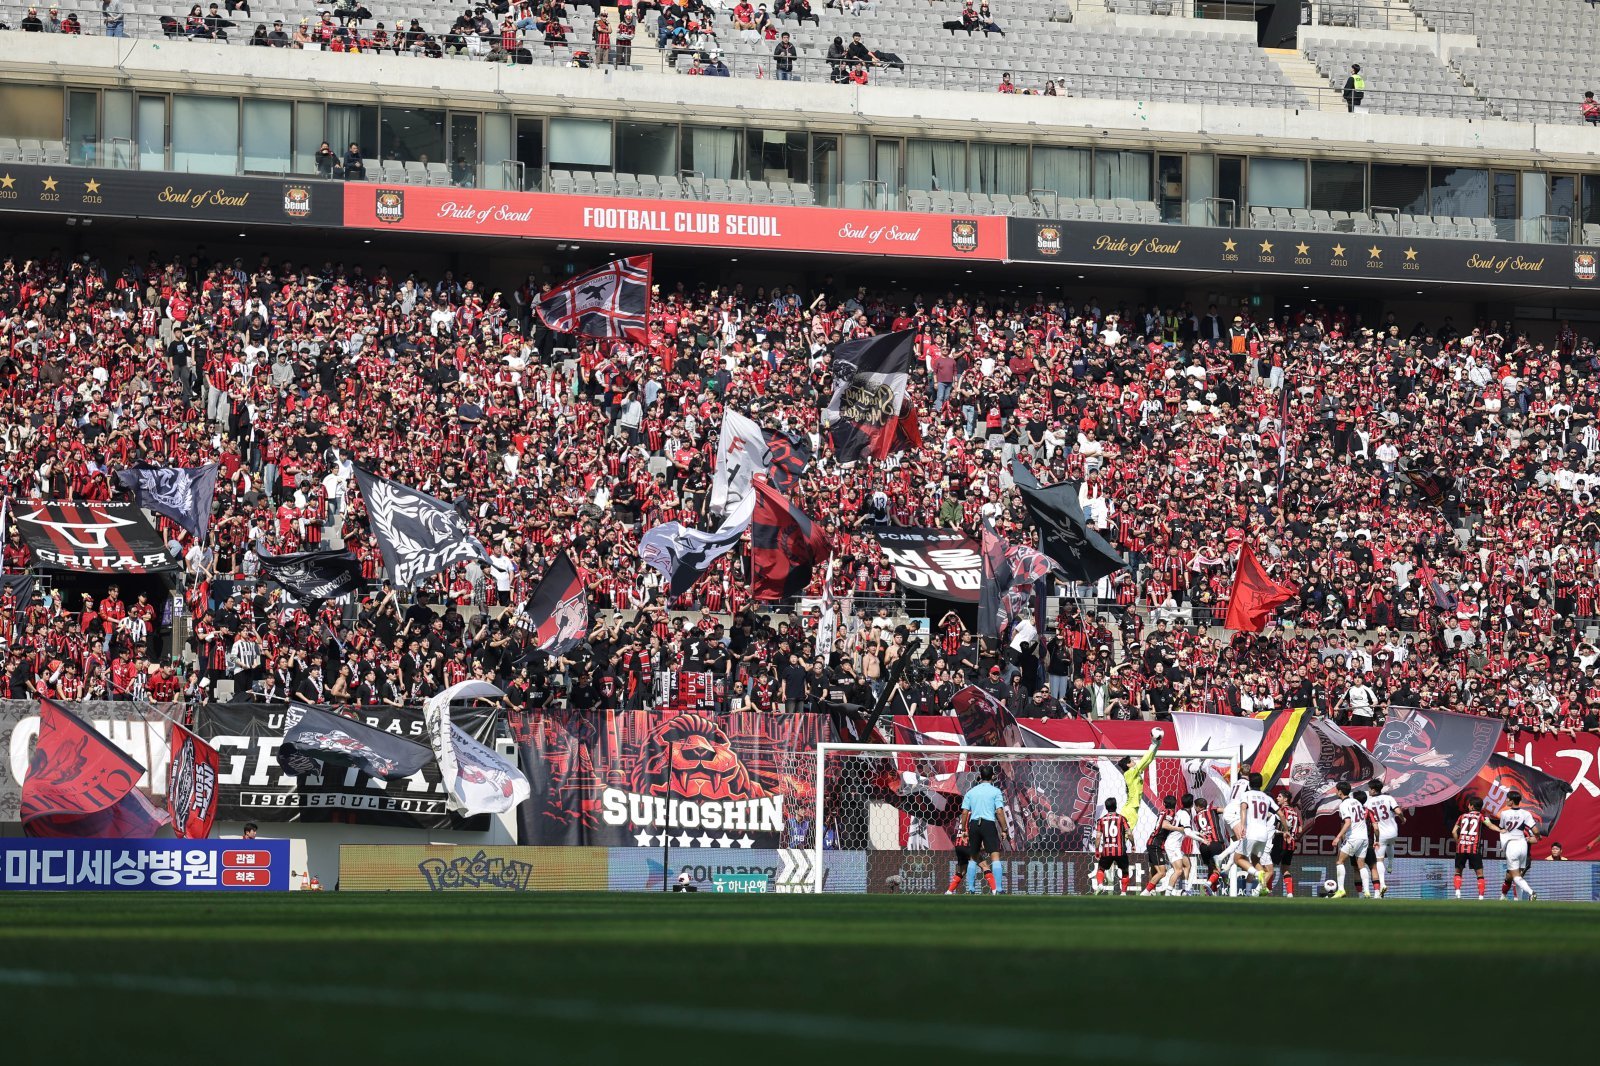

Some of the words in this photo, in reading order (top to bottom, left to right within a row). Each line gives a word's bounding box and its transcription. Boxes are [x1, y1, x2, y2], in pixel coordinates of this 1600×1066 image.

[40, 192, 60, 201] 2012
[82, 195, 102, 204] 2016
[157, 186, 192, 204] Soul
[190, 189, 211, 208] of
[210, 188, 250, 207] Seoul
[437, 201, 476, 219] Pride
[476, 205, 496, 224] of
[494, 204, 533, 222] Seoul
[583, 207, 670, 231] FOOTBALL
[674, 211, 720, 233] CLUB
[726, 214, 781, 236] SEOUL
[838, 222, 867, 239] Soul
[868, 226, 887, 244] of
[885, 225, 921, 242] Seoul
[1092, 234, 1129, 252] Pride
[1128, 238, 1147, 257] of
[1145, 237, 1181, 254] Seoul
[1221, 253, 1239, 262] 1985
[1258, 255, 1275, 263] 1990
[1294, 257, 1312, 265] 2000
[1330, 258, 1348, 267] 2010
[1366, 260, 1384, 269] 2012
[1402, 262, 1420, 271] 2016
[1466, 253, 1494, 269] Soul
[1494, 256, 1512, 274] of
[1510, 255, 1544, 272] Seoul
[36, 548, 168, 568] GRITAR
[192, 763, 204, 811] SEOUL
[250, 794, 301, 806] 1983
[310, 795, 378, 808] SEOUL
[386, 799, 438, 812] 2017
[602, 787, 785, 832] SUHOSHIN
[1252, 800, 1267, 820] 19
[1103, 820, 1118, 838] 16
[1459, 818, 1479, 836] 22
[5, 849, 217, 886] 마디세상병원
[235, 854, 255, 864] 관절
[235, 872, 255, 882] 척추
[728, 881, 767, 893] 하나은행
